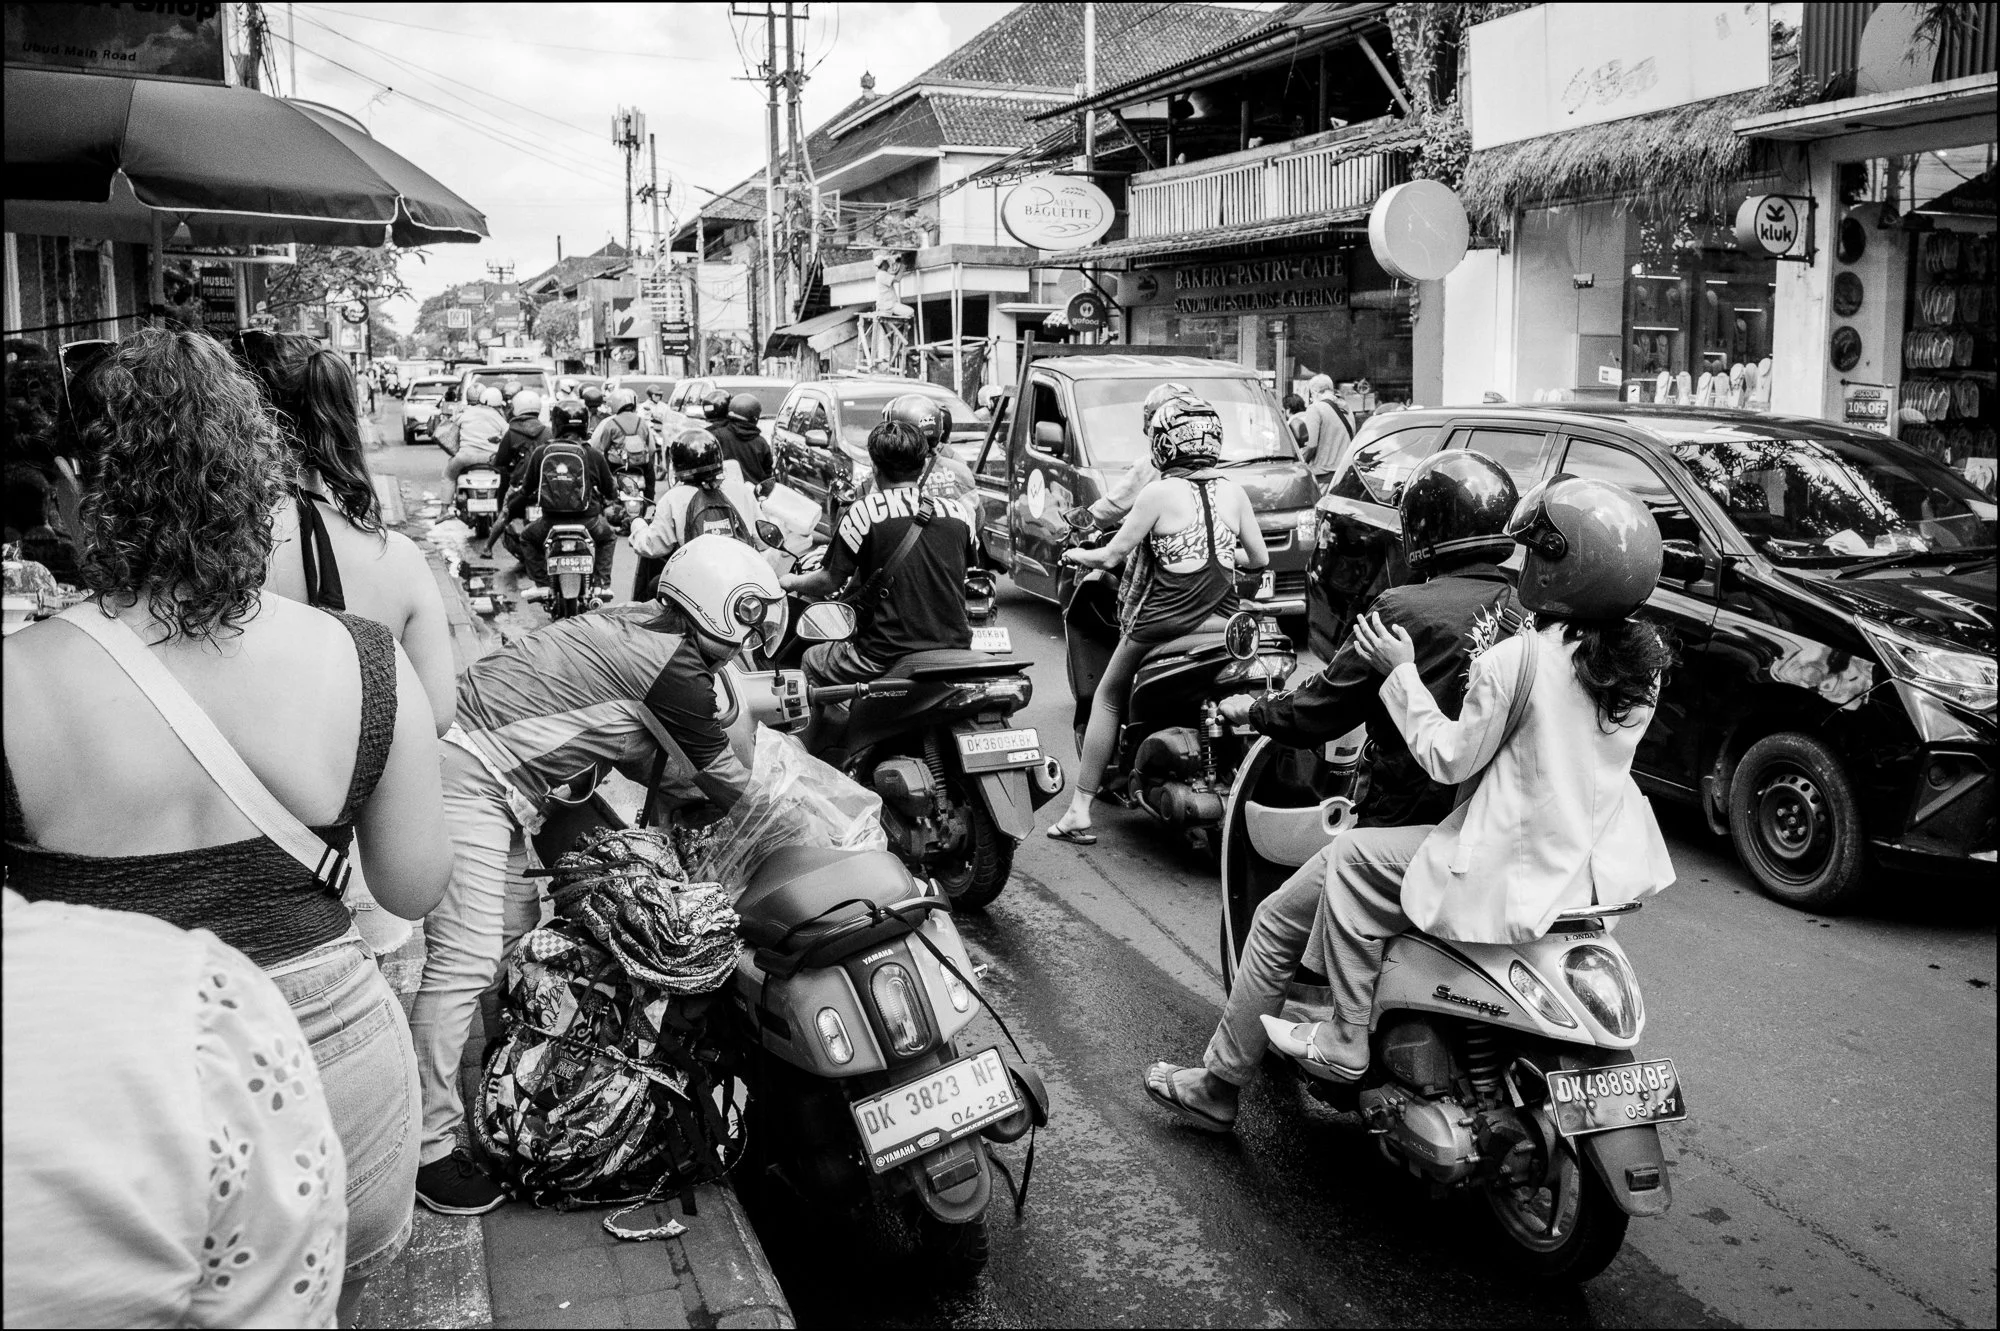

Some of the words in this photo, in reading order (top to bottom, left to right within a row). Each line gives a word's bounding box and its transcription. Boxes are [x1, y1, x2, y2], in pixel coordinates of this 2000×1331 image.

[22, 41, 60, 55] Ubud
[64, 46, 98, 58] Main
[103, 49, 136, 61] Road
[1025, 205, 1092, 219] BAGUETTE
[1761, 223, 1791, 242] kluk
[1072, 318, 1099, 326] gofood
[1847, 402, 1867, 413] 10%
[1868, 402, 1886, 413] OFF
[838, 486, 920, 555] ROCKY
[1409, 547, 1431, 563] ARC
[1564, 931, 1596, 942] HONDA
[862, 948, 894, 965] YAMAHA
[1432, 984, 1510, 1016] Scoopy
[863, 1102, 896, 1135] DK
[906, 1075, 960, 1116] 3823
[971, 1057, 998, 1087] NF
[884, 1143, 916, 1164] YAMAHA
